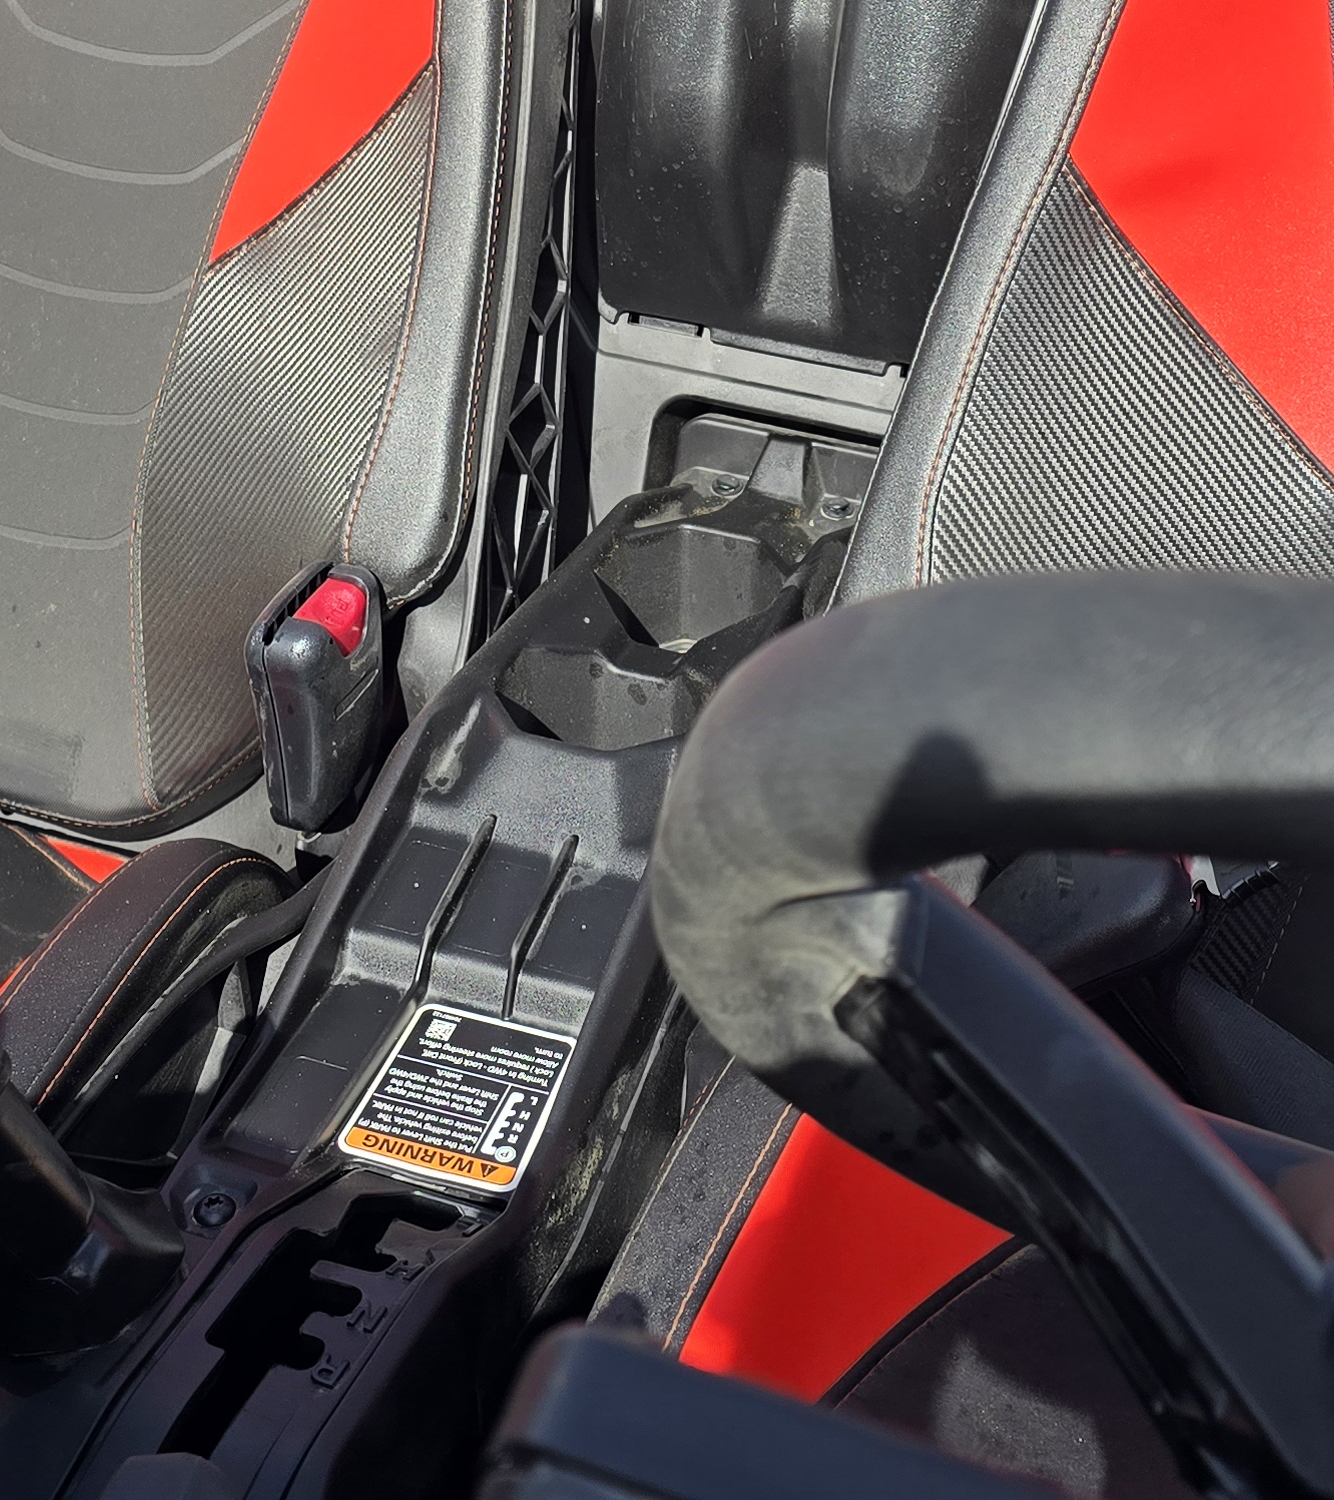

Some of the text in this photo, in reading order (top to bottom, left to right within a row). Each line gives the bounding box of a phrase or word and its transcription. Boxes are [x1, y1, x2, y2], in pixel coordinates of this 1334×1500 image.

[442, 1043, 475, 1057] steering
[475, 1052, 497, 1062] more
[490, 1046, 559, 1069] Allow more room
[553, 1052, 563, 1060] to
[463, 1059, 483, 1070] Lock
[497, 1057, 530, 1071] requires
[487, 1066, 508, 1076] 4WD
[390, 1078, 404, 1087] the
[429, 1077, 443, 1086] the
[517, 1072, 550, 1087] Turning
[402, 1080, 426, 1091] using
[442, 1081, 459, 1090] and
[458, 1085, 481, 1096] Lever
[425, 1086, 451, 1099] before
[480, 1090, 499, 1101] Shift
[384, 1085, 484, 1116] Stop the vehicle and apply
[473, 1099, 487, 1108] the
[530, 1096, 538, 1106] L
[377, 1112, 392, 1123] The
[403, 1108, 419, 1117] not
[423, 1114, 439, 1122] roll
[518, 1110, 531, 1121] H
[368, 1121, 392, 1133] PARK
[439, 1117, 454, 1126] can
[454, 1121, 482, 1133] vehicle
[391, 1127, 401, 1135] to
[511, 1122, 524, 1133] N
[400, 1129, 424, 1141] Lever
[423, 1135, 444, 1146] Shift
[451, 1131, 478, 1144] before
[507, 1134, 519, 1144] R
[443, 1140, 458, 1149] the
[457, 1143, 473, 1153] Put
[362, 1134, 474, 1173] WARNING
[346, 1299, 390, 1333] N
[311, 1353, 350, 1389] R
